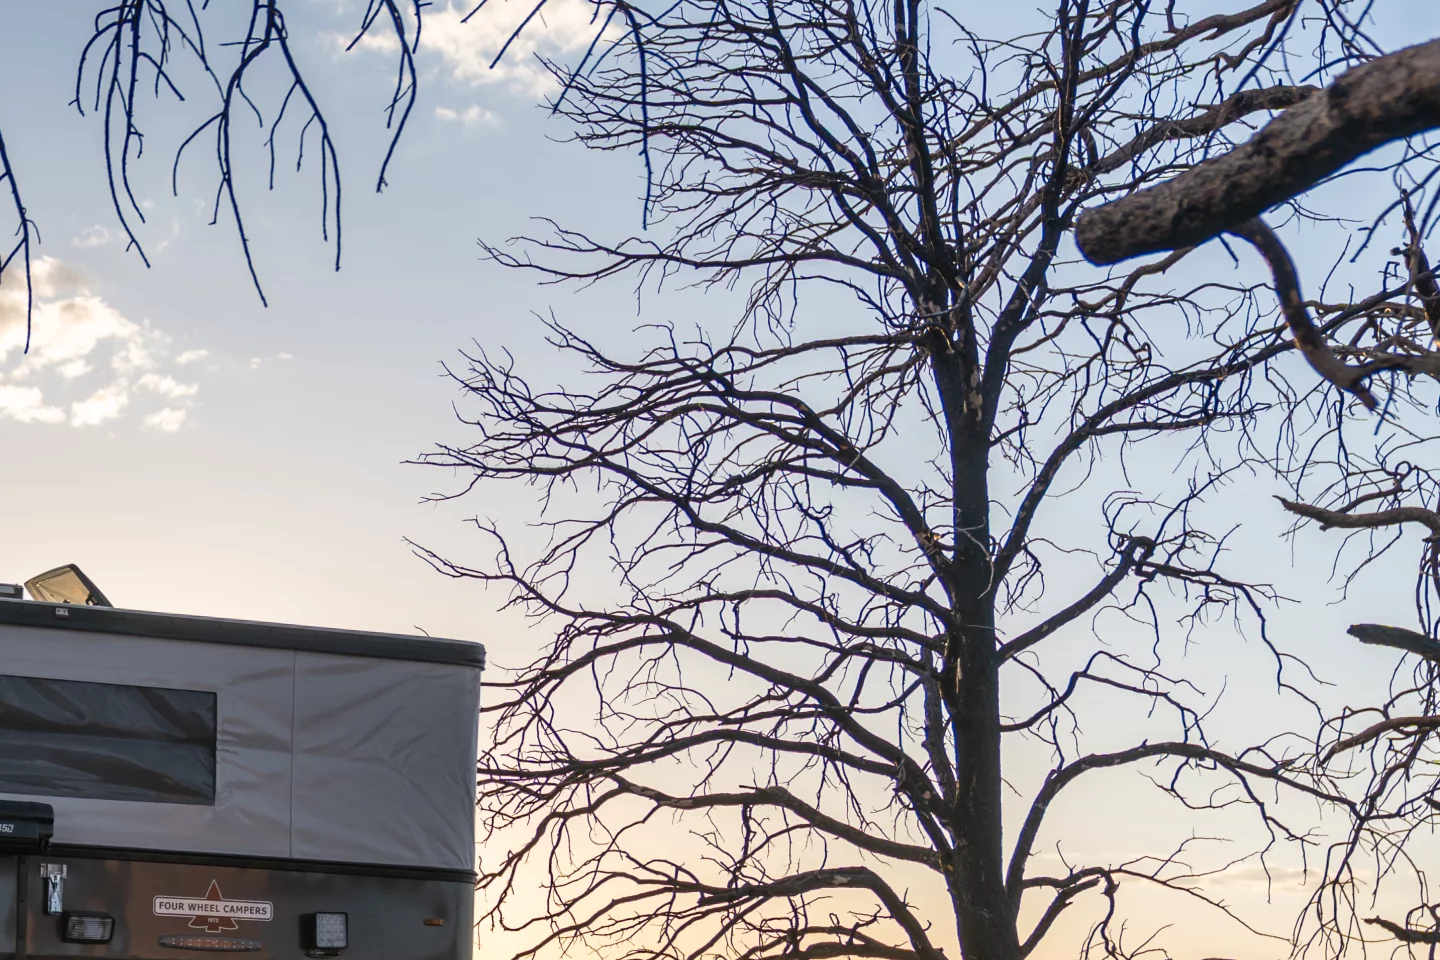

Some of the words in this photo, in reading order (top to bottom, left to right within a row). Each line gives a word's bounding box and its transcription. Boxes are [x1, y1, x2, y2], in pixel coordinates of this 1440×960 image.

[158, 901, 185, 911] FOUR
[188, 902, 221, 913] WHEEL
[223, 904, 268, 916] CAMPERS
